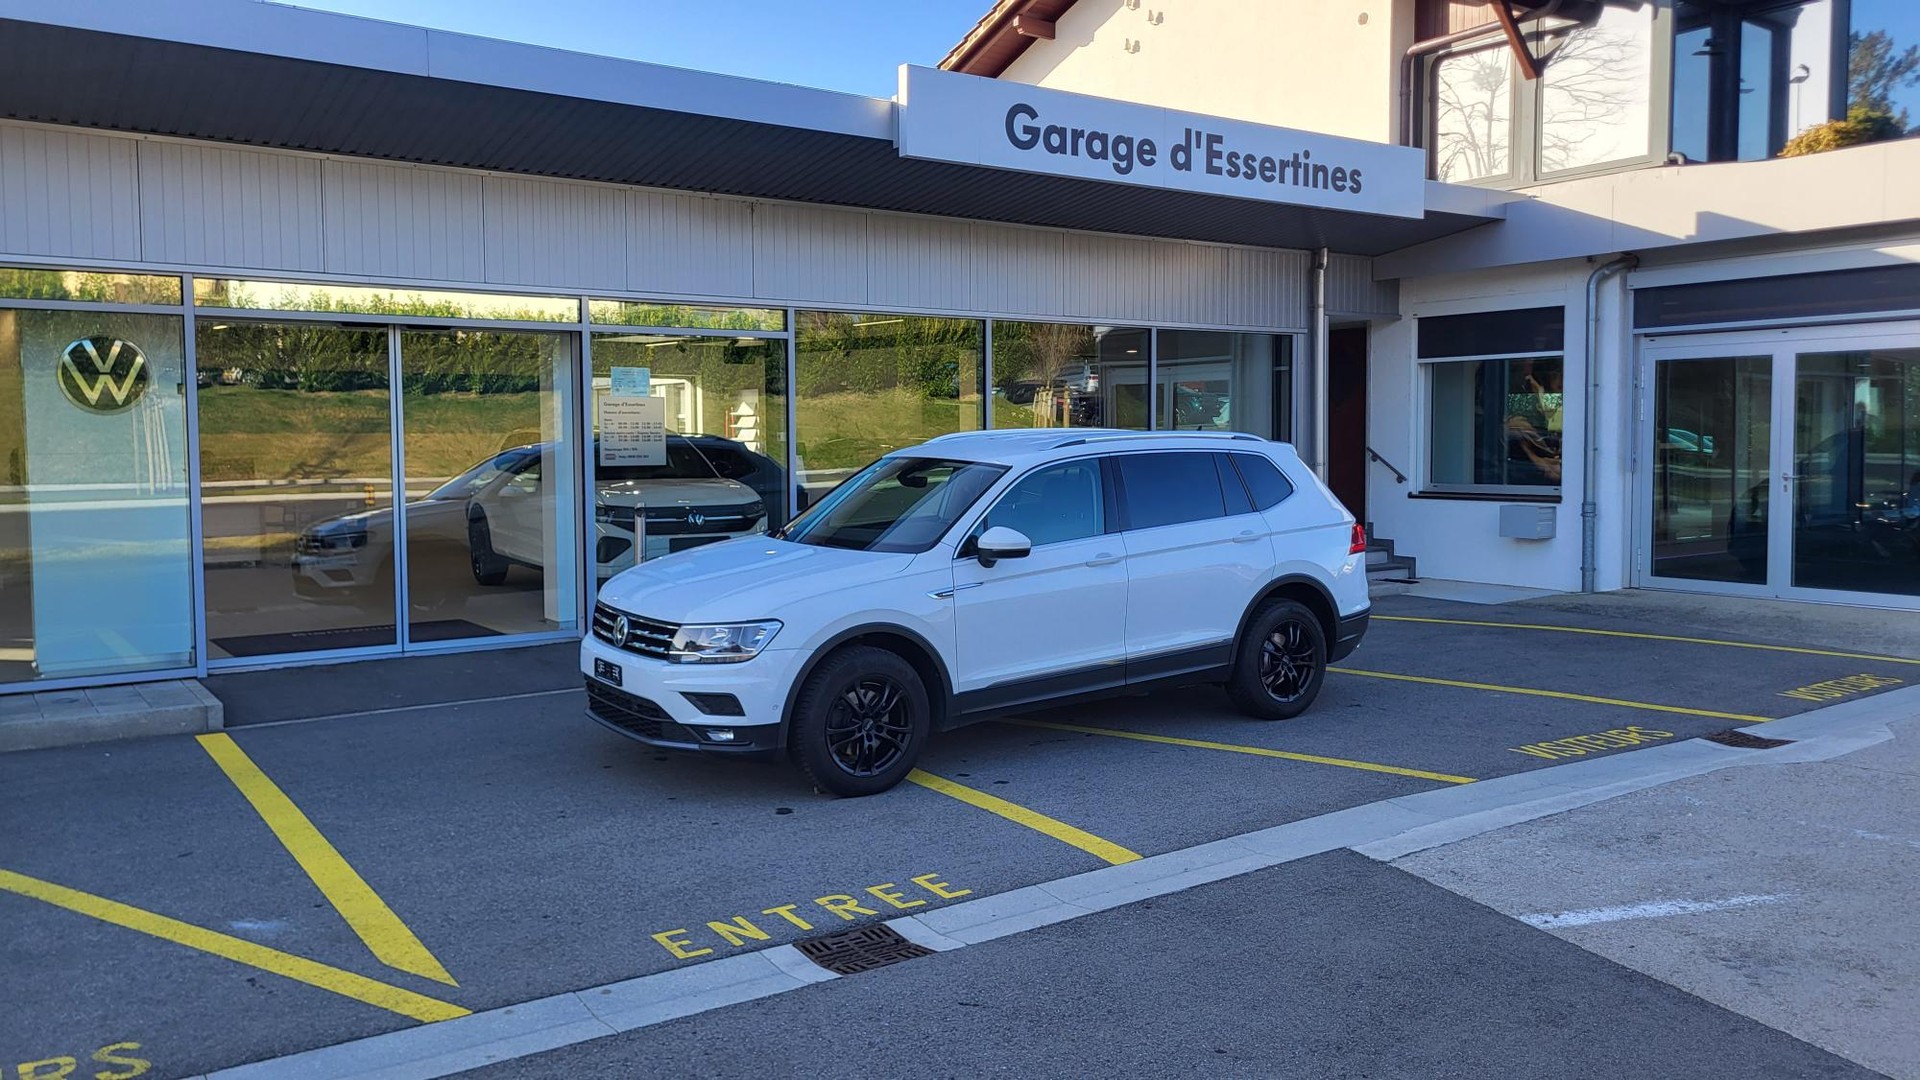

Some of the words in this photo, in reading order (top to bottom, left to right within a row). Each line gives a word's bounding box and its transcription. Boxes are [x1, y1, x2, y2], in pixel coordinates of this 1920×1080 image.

[1005, 103, 1157, 175] Garage
[1170, 127, 1362, 194] d'Essertines
[61, 338, 145, 406] VW
[1508, 726, 1674, 760] VISITEURS
[651, 873, 973, 959] ENTREE
[0, 1041, 152, 1080] RS
